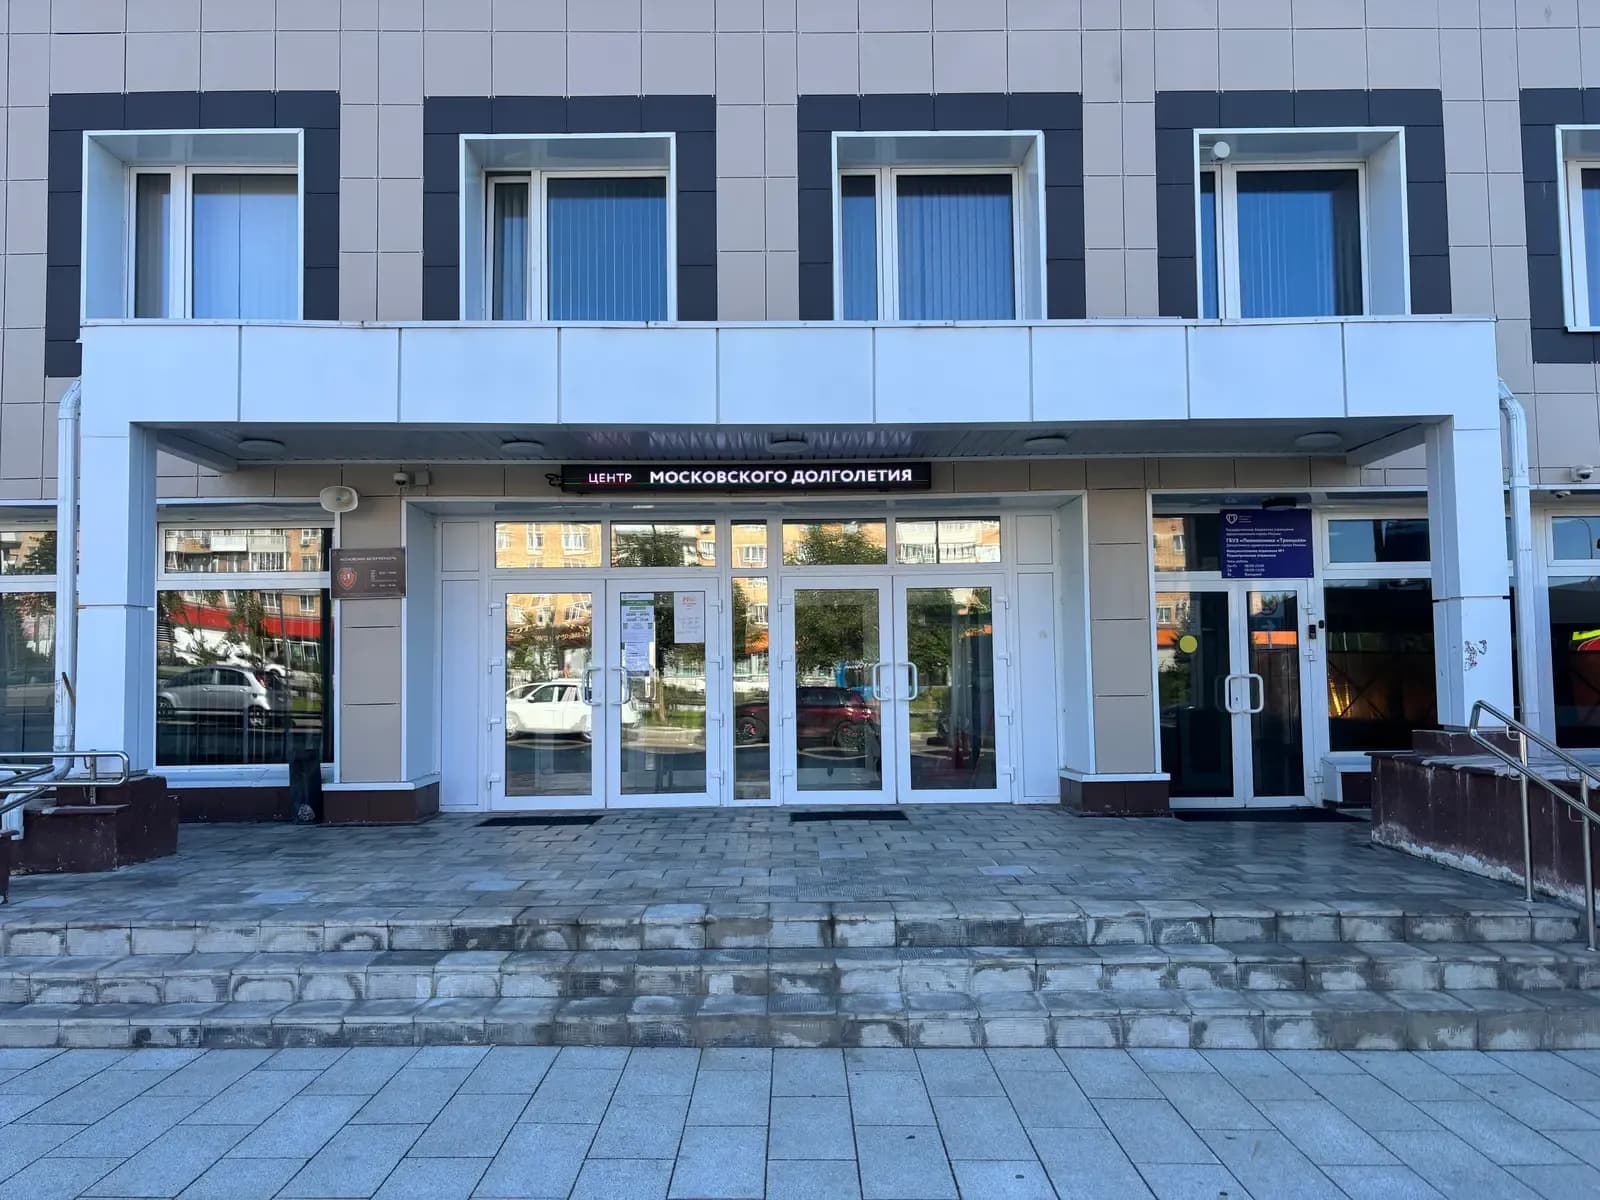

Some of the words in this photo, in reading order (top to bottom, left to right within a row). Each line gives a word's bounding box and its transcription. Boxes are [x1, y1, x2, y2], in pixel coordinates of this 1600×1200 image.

[588, 473, 632, 484] ЦЕНТР
[650, 470, 787, 485] МОСКОВСКОГО
[791, 469, 912, 485] ДОЛГОЛЕТИЯ
